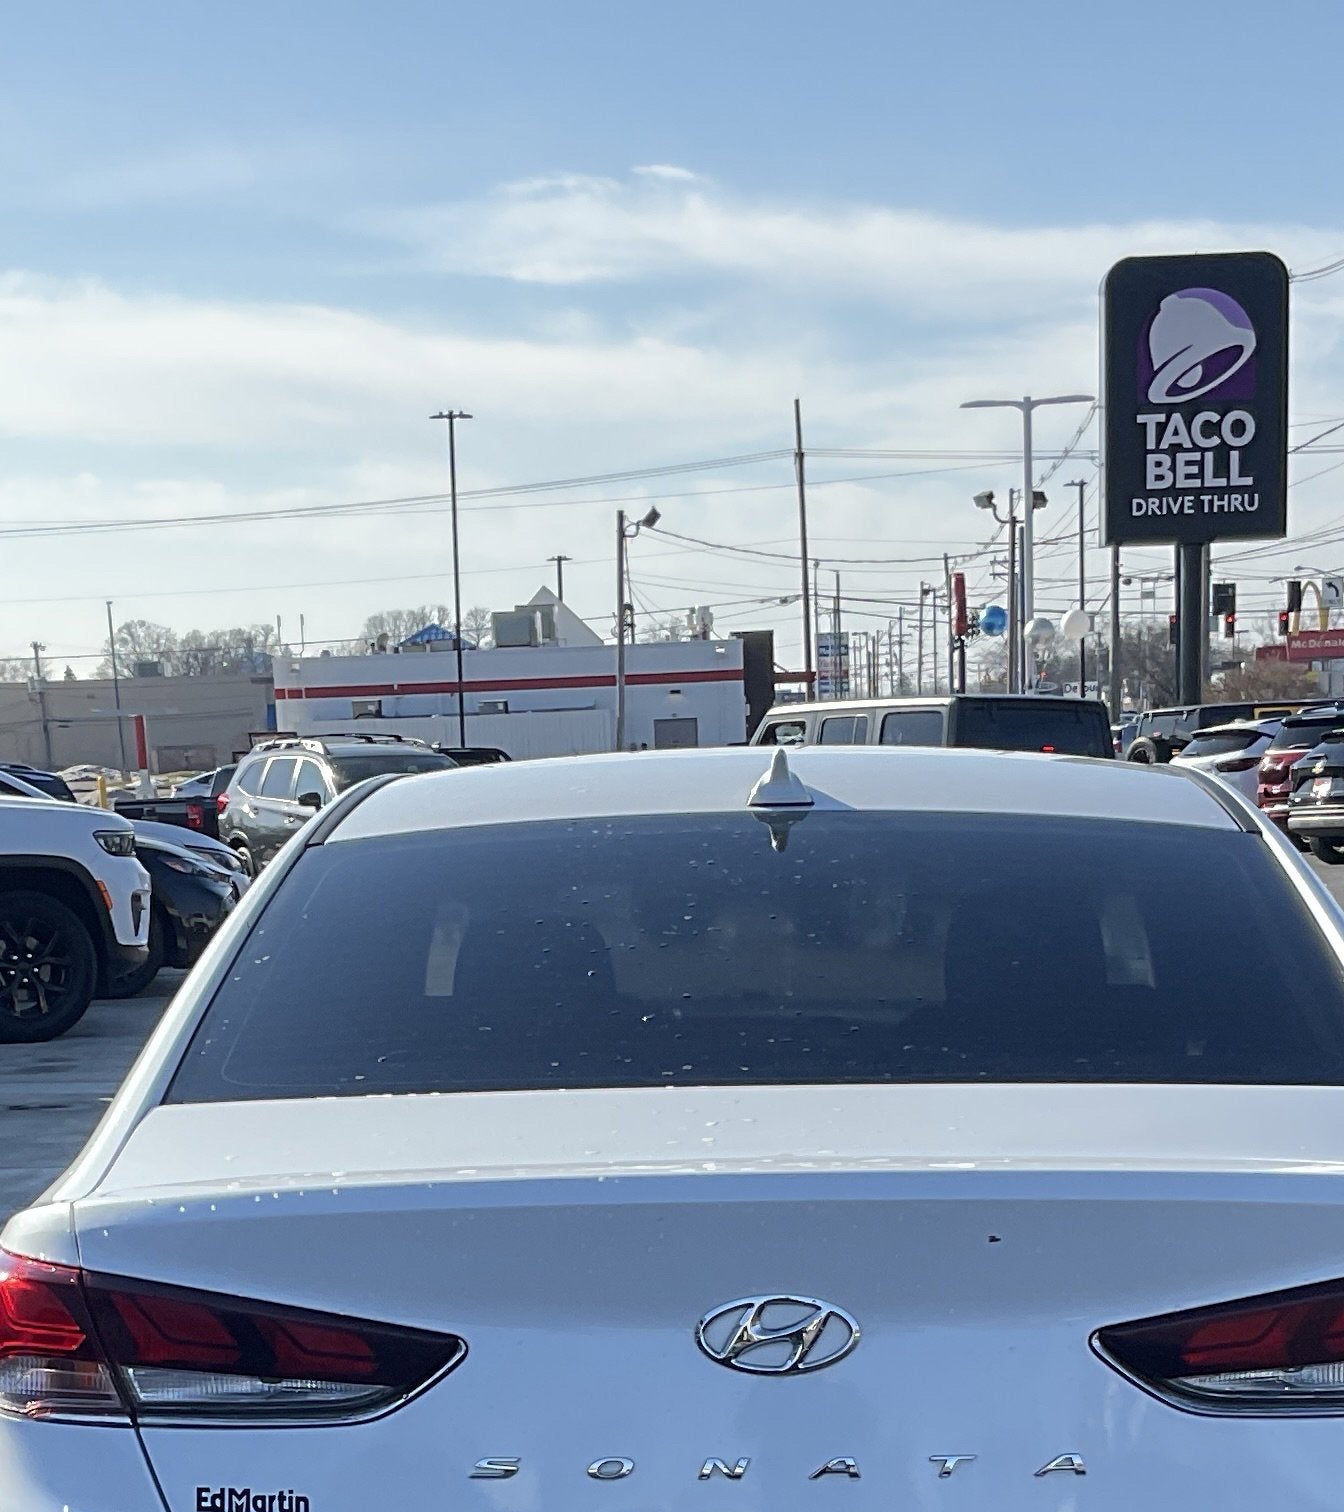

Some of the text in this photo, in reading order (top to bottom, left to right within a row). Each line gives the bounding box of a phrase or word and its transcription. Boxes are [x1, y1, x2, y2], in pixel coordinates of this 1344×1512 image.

[1136, 409, 1256, 450] TACO
[1146, 450, 1254, 490] BELL
[1132, 493, 1259, 516] DRIVE THRU
[468, 1453, 1088, 1480] SONATA
